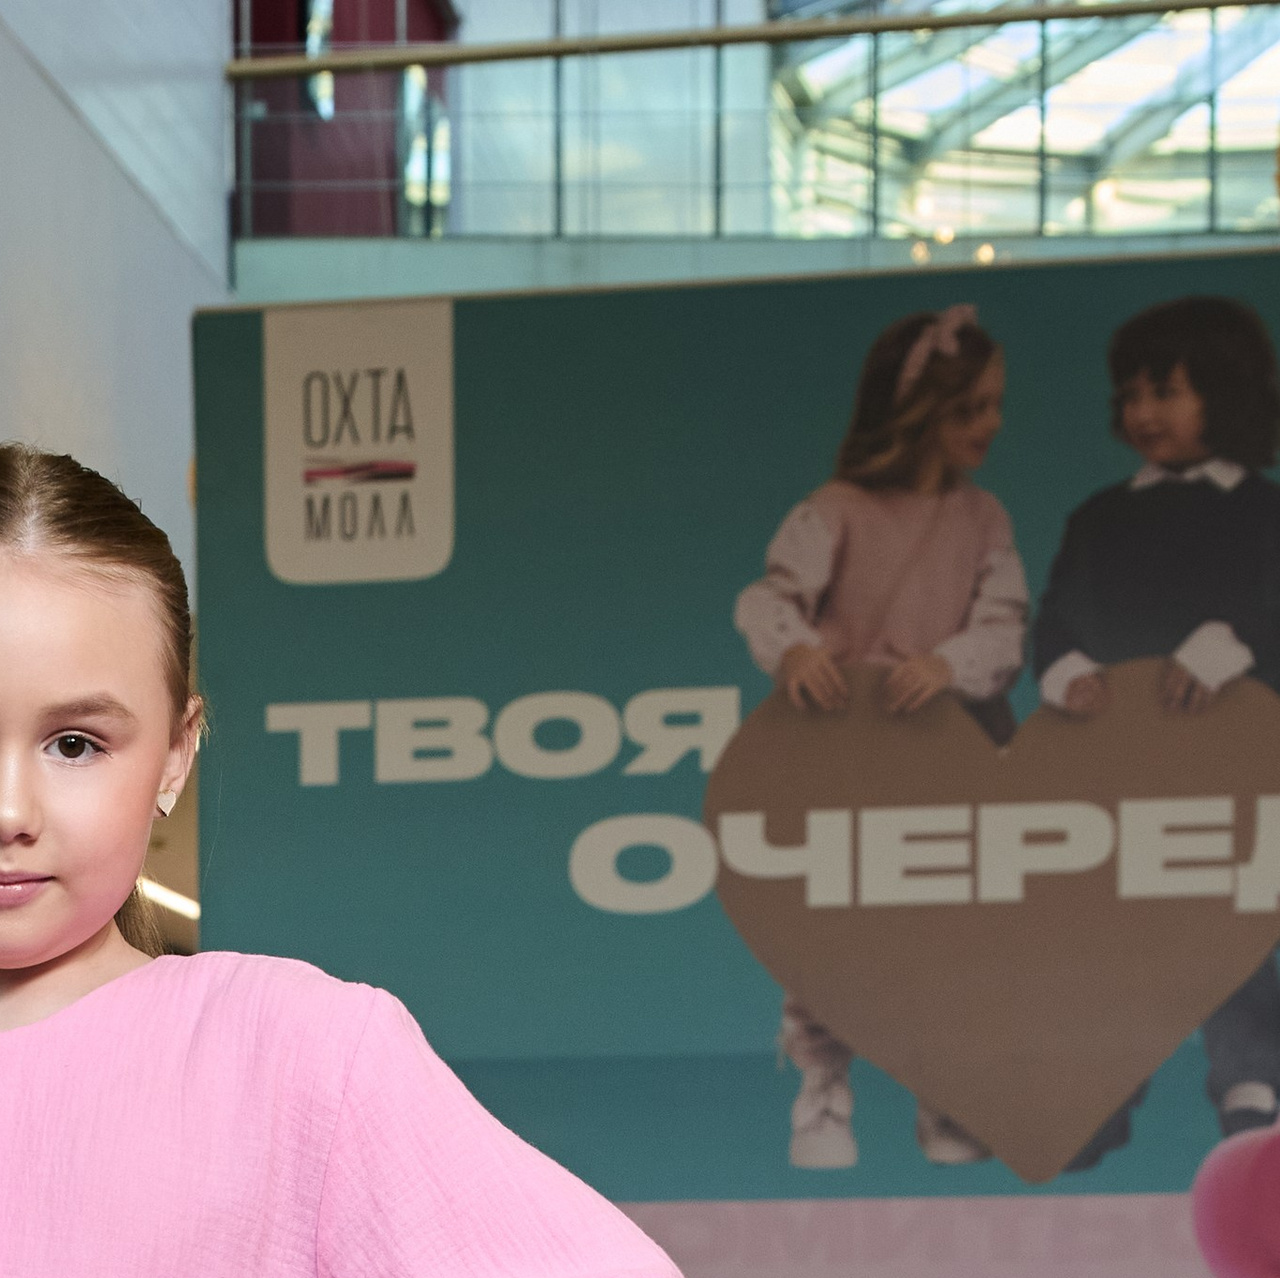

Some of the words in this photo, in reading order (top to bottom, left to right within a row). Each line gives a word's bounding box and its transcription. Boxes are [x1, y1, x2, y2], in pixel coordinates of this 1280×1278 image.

[302, 367, 416, 449] ОХТА
[303, 489, 417, 542] МОЛЛ
[265, 686, 742, 788] ТВОЯ
